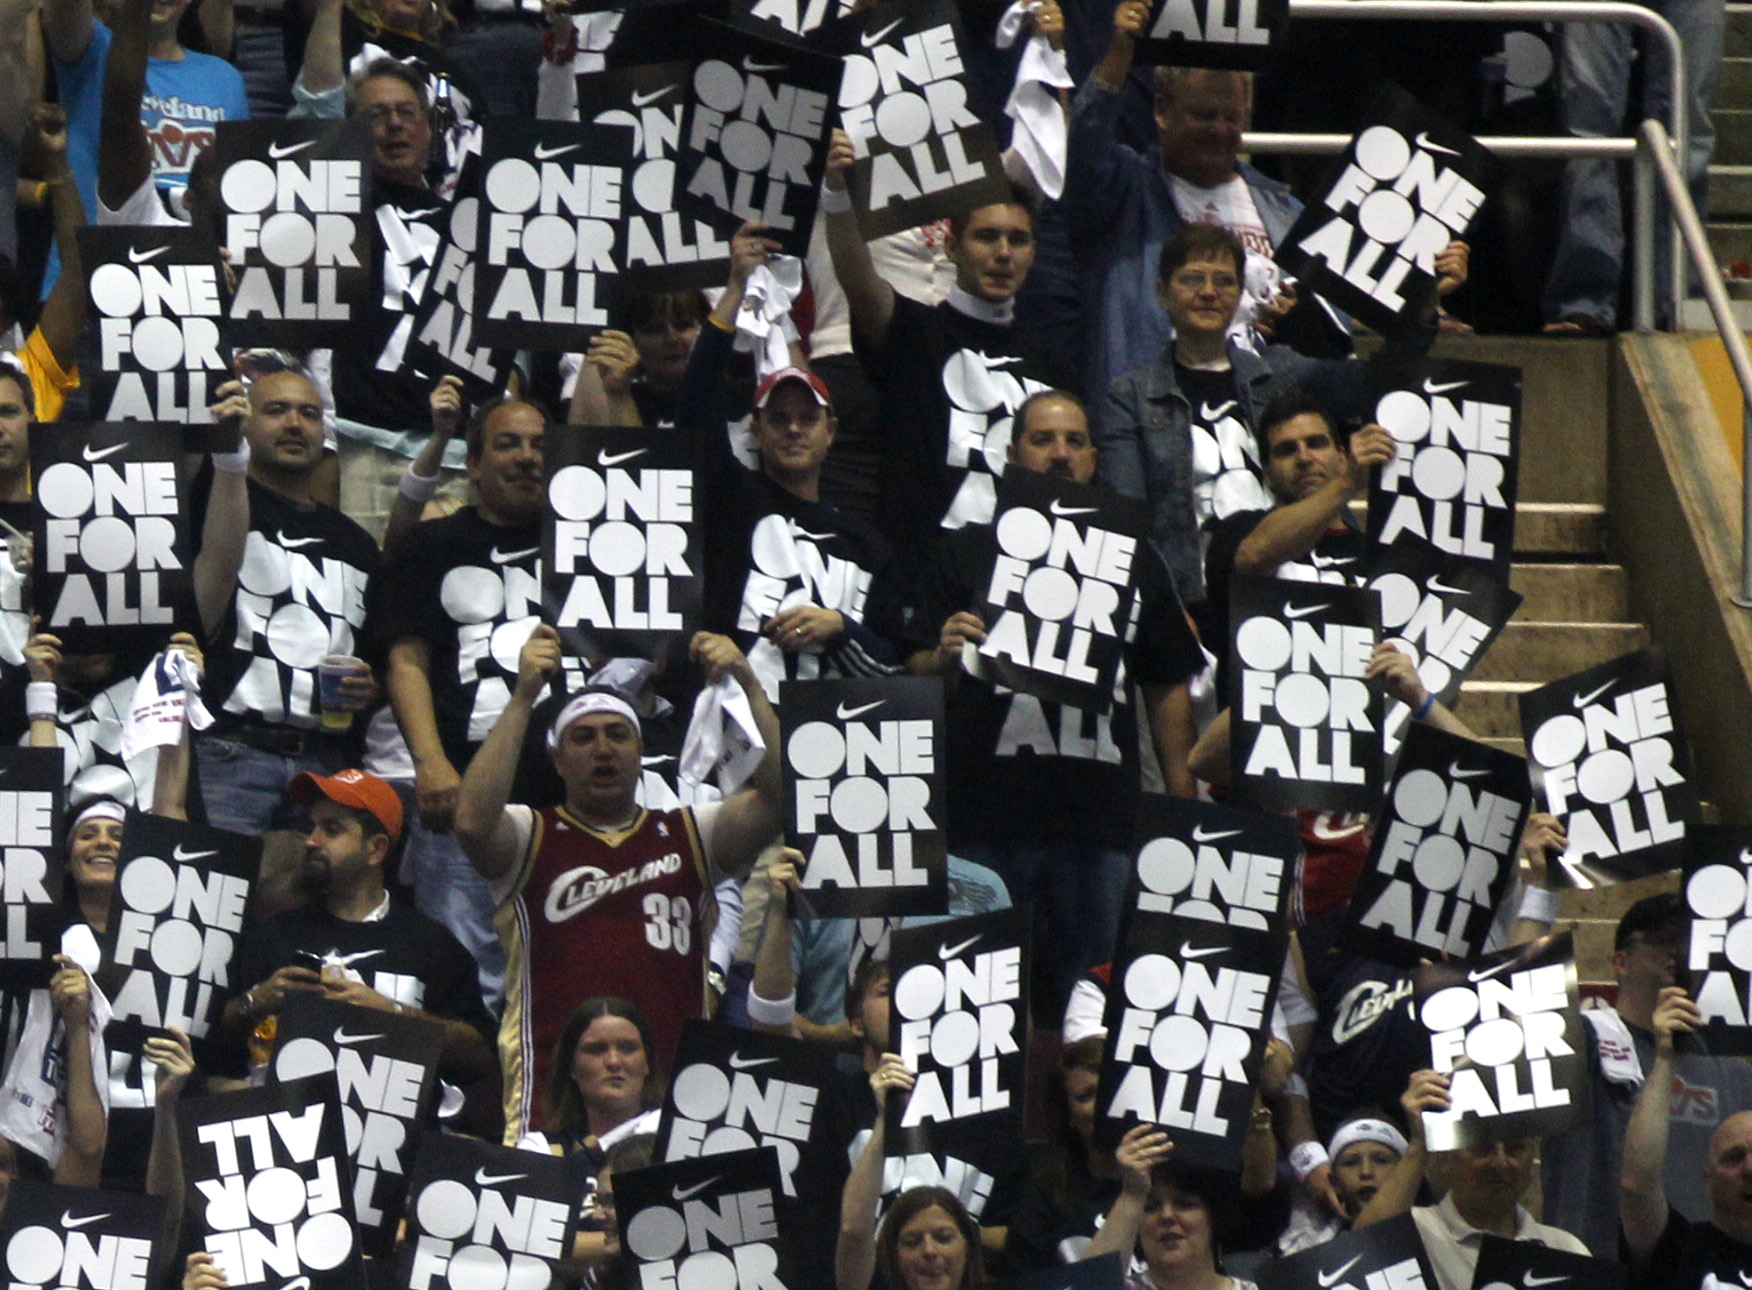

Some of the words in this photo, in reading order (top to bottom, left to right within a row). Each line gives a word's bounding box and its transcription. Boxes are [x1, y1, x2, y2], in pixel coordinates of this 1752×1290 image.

[694, 61, 828, 143] ONE
[689, 104, 815, 192] FOR
[1356, 127, 1487, 235] ONE
[221, 159, 362, 215] ONE
[684, 156, 796, 235] ALL
[1324, 162, 1458, 278] FOR
[226, 212, 361, 269] FOR
[1298, 216, 1411, 314] ALL
[230, 267, 354, 321] ALL
[37, 460, 179, 520] ONE
[549, 466, 693, 523] ONE
[45, 514, 182, 573] FOR
[553, 519, 693, 579] FOR
[997, 507, 1137, 587] ONE
[54, 571, 177, 627] ALL
[558, 574, 686, 631] ALL
[988, 553, 1123, 638] FOR
[980, 609, 1101, 686] ALL
[1236, 616, 1374, 679] ONE
[1241, 668, 1374, 733] FOR
[1531, 683, 1674, 767] ONE
[1245, 724, 1368, 785] ALL
[1541, 730, 1686, 819] FOR
[1562, 789, 1689, 870] ALL
[643, 892, 692, 956] 33
[895, 946, 1020, 1021] ONE
[1423, 964, 1569, 1032] ONE
[899, 998, 1020, 1076] FOR
[1431, 1007, 1577, 1076] FOR
[902, 1058, 1014, 1131] ALL
[1442, 1059, 1576, 1122] ALL
[194, 1104, 324, 1176] ALL
[194, 1158, 343, 1238] FOR
[627, 1186, 779, 1263] ONE
